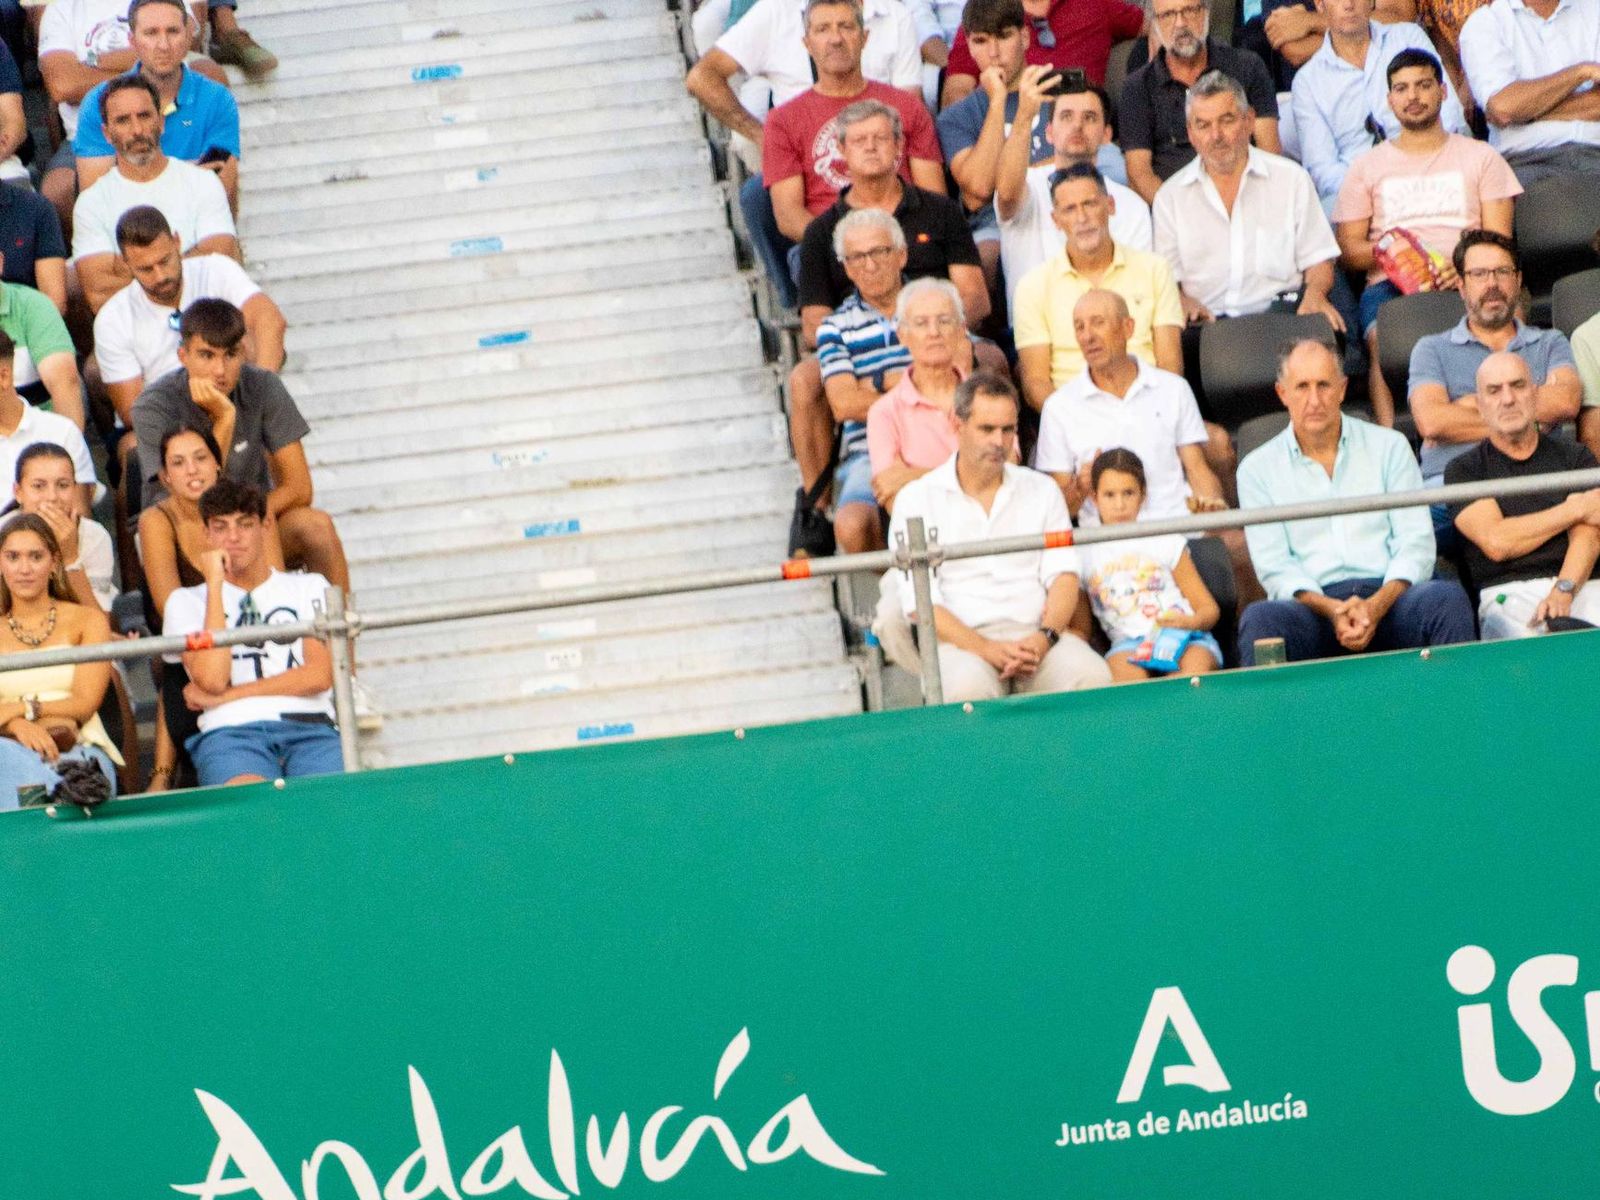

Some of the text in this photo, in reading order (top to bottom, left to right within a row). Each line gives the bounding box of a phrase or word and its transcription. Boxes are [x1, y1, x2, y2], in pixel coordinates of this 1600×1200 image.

[1446, 945, 1600, 1116] iS
[1055, 1092, 1309, 1146] Junta de Andalucía
